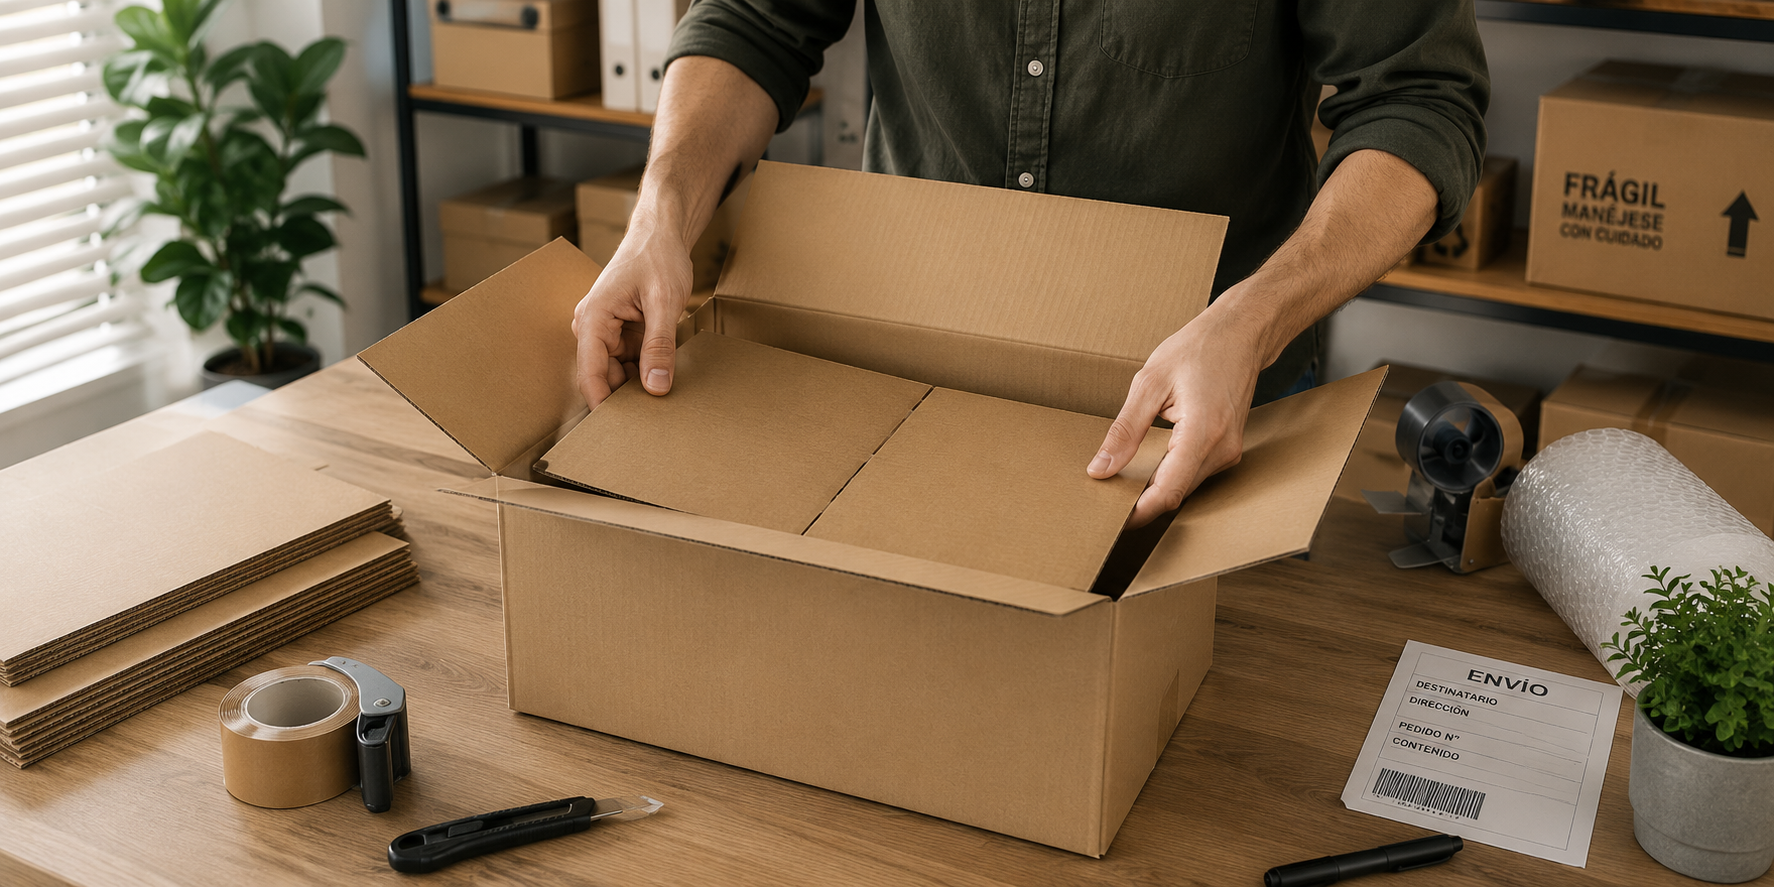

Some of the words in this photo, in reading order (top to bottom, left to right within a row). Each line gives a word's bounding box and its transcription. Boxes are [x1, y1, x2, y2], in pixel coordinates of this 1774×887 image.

[1564, 170, 1666, 209] FRÁGIL
[1562, 202, 1664, 232] MANÉJESE
[1559, 222, 1592, 240] CON
[1595, 227, 1663, 251] CUIDADO
[1416, 680, 1498, 706] DESTINATARIO
[1398, 721, 1442, 738] PEDIDO
[1392, 737, 1460, 761] CONTENIDO
